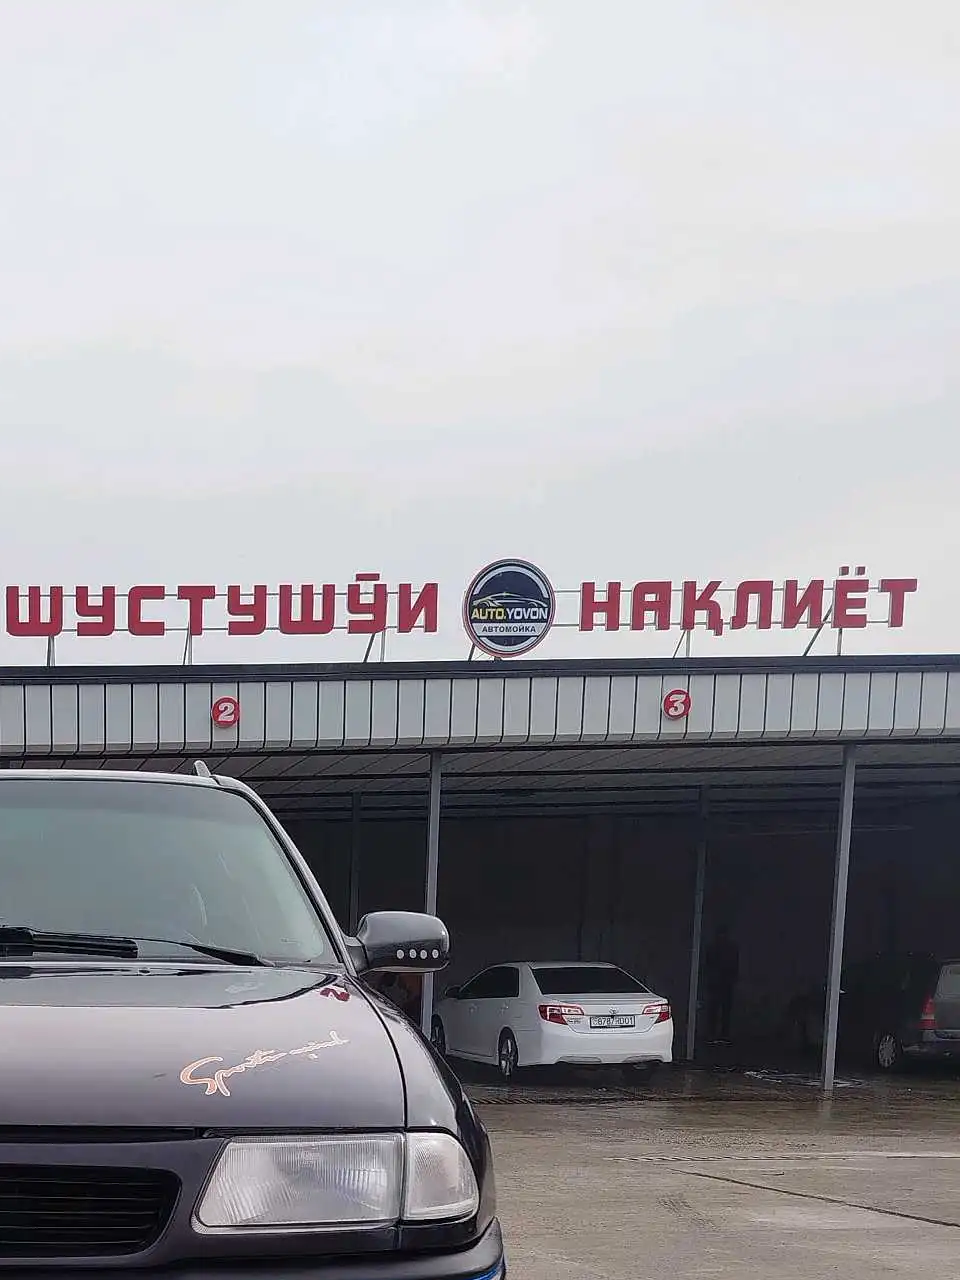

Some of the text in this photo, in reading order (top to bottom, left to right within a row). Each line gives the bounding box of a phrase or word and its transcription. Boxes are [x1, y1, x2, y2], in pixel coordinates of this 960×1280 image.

[6, 566, 918, 637] ШУСТУШӮИ НАҚЛИЁТ
[218, 702, 235, 721] 2
[668, 694, 686, 716] 3
